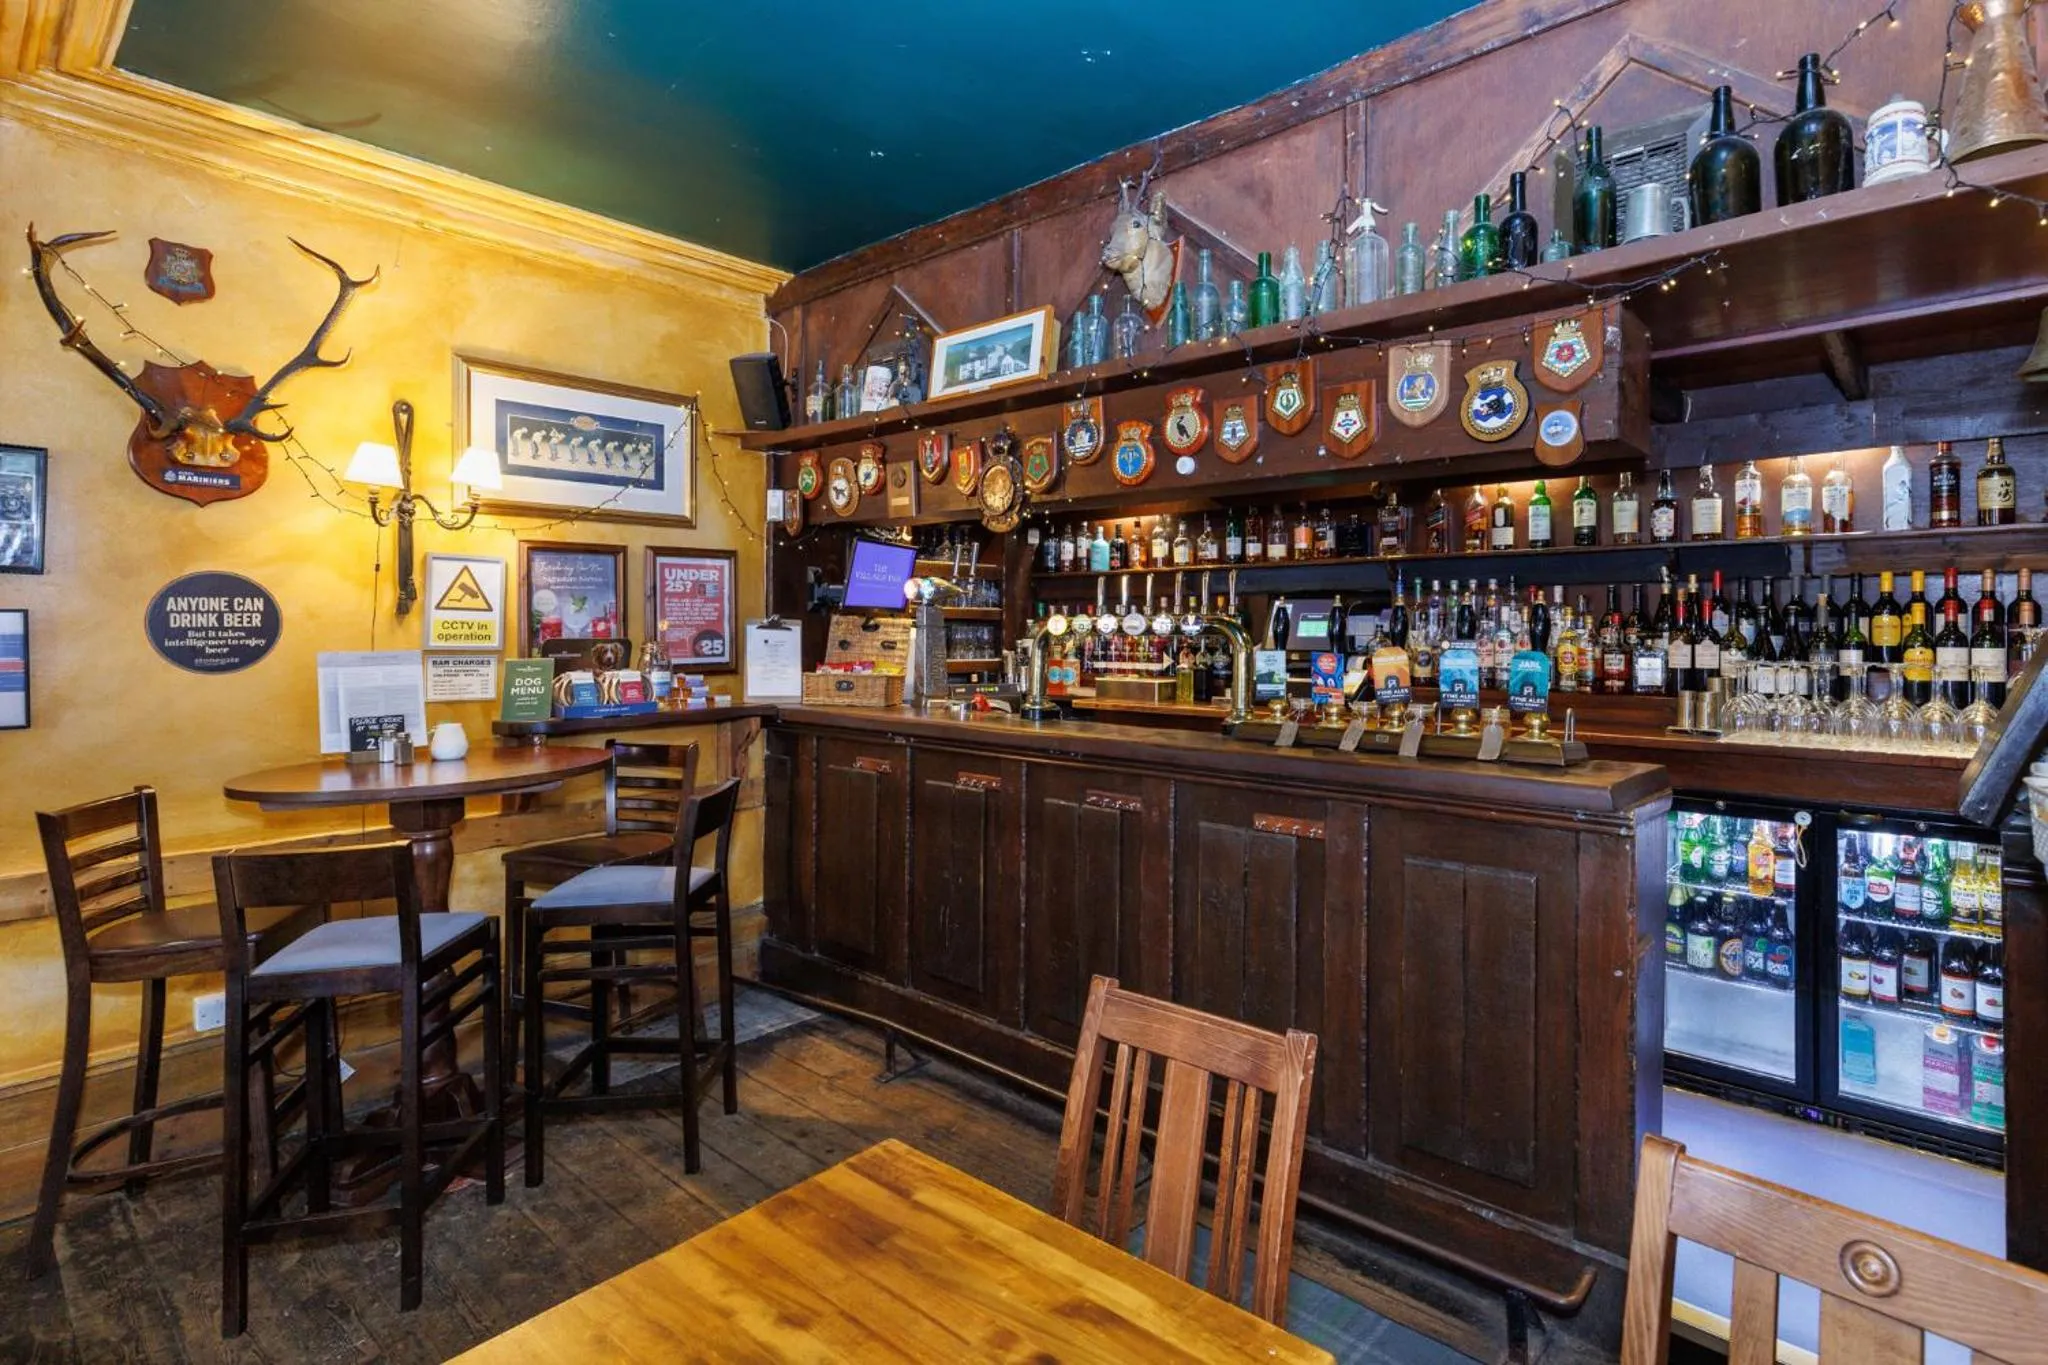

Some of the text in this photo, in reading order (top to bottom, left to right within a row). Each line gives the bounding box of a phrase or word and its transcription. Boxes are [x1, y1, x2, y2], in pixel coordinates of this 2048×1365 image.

[664, 567, 720, 581] UNDER
[664, 580, 693, 593] 25?
[166, 597, 265, 612] ANYONE CAN
[169, 612, 262, 628] DRINK BEER
[441, 620, 489, 631] CCTV in
[217, 630, 246, 638] takes
[436, 632, 492, 642] operation
[227, 638, 239, 647] to
[239, 637, 267, 648] enjoy
[701, 639, 724, 655] 25
[205, 647, 231, 655] beer
[515, 677, 542, 687] DOG
[510, 685, 545, 695] MENU
